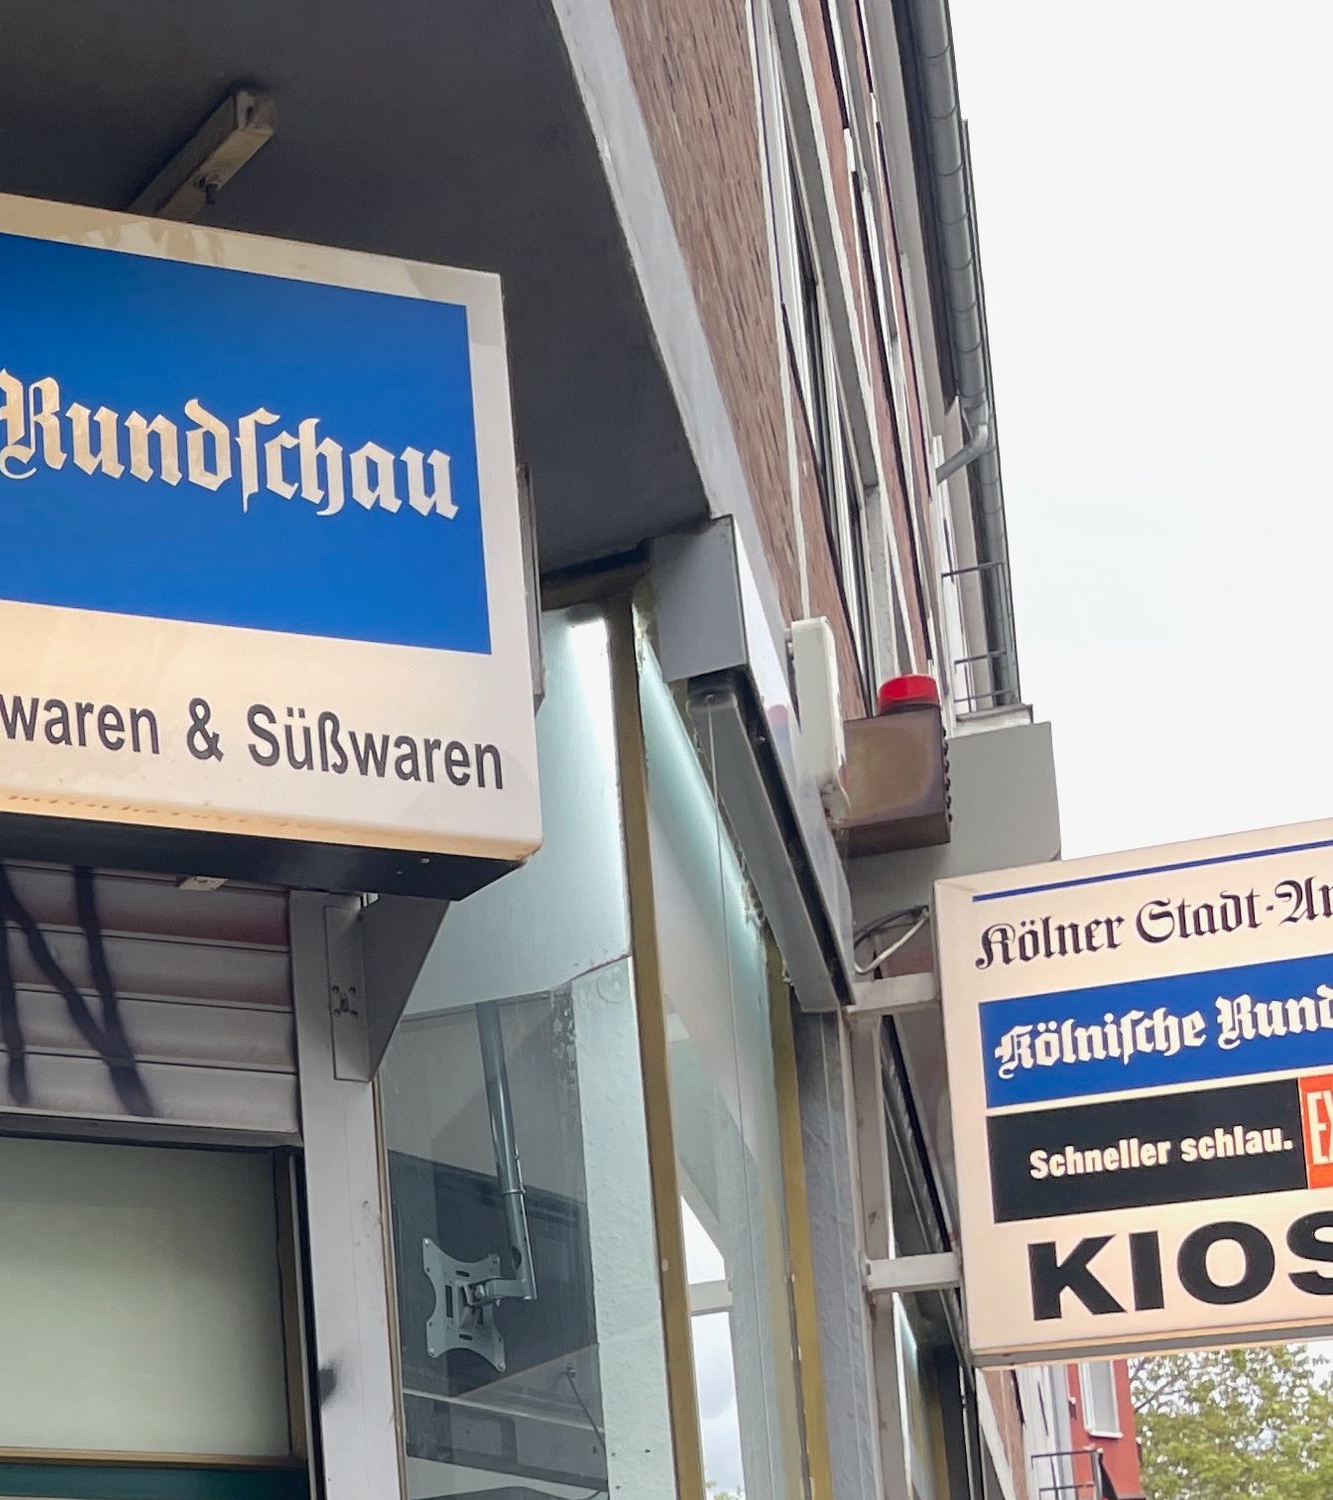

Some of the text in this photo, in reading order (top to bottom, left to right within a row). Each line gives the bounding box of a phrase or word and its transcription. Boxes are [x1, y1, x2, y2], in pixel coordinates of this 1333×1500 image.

[186, 698, 224, 762] &
[247, 704, 504, 790] Süßwaren
[975, 916, 1126, 970] Kölner
[1030, 1126, 1294, 1180] Schneller schlau.
